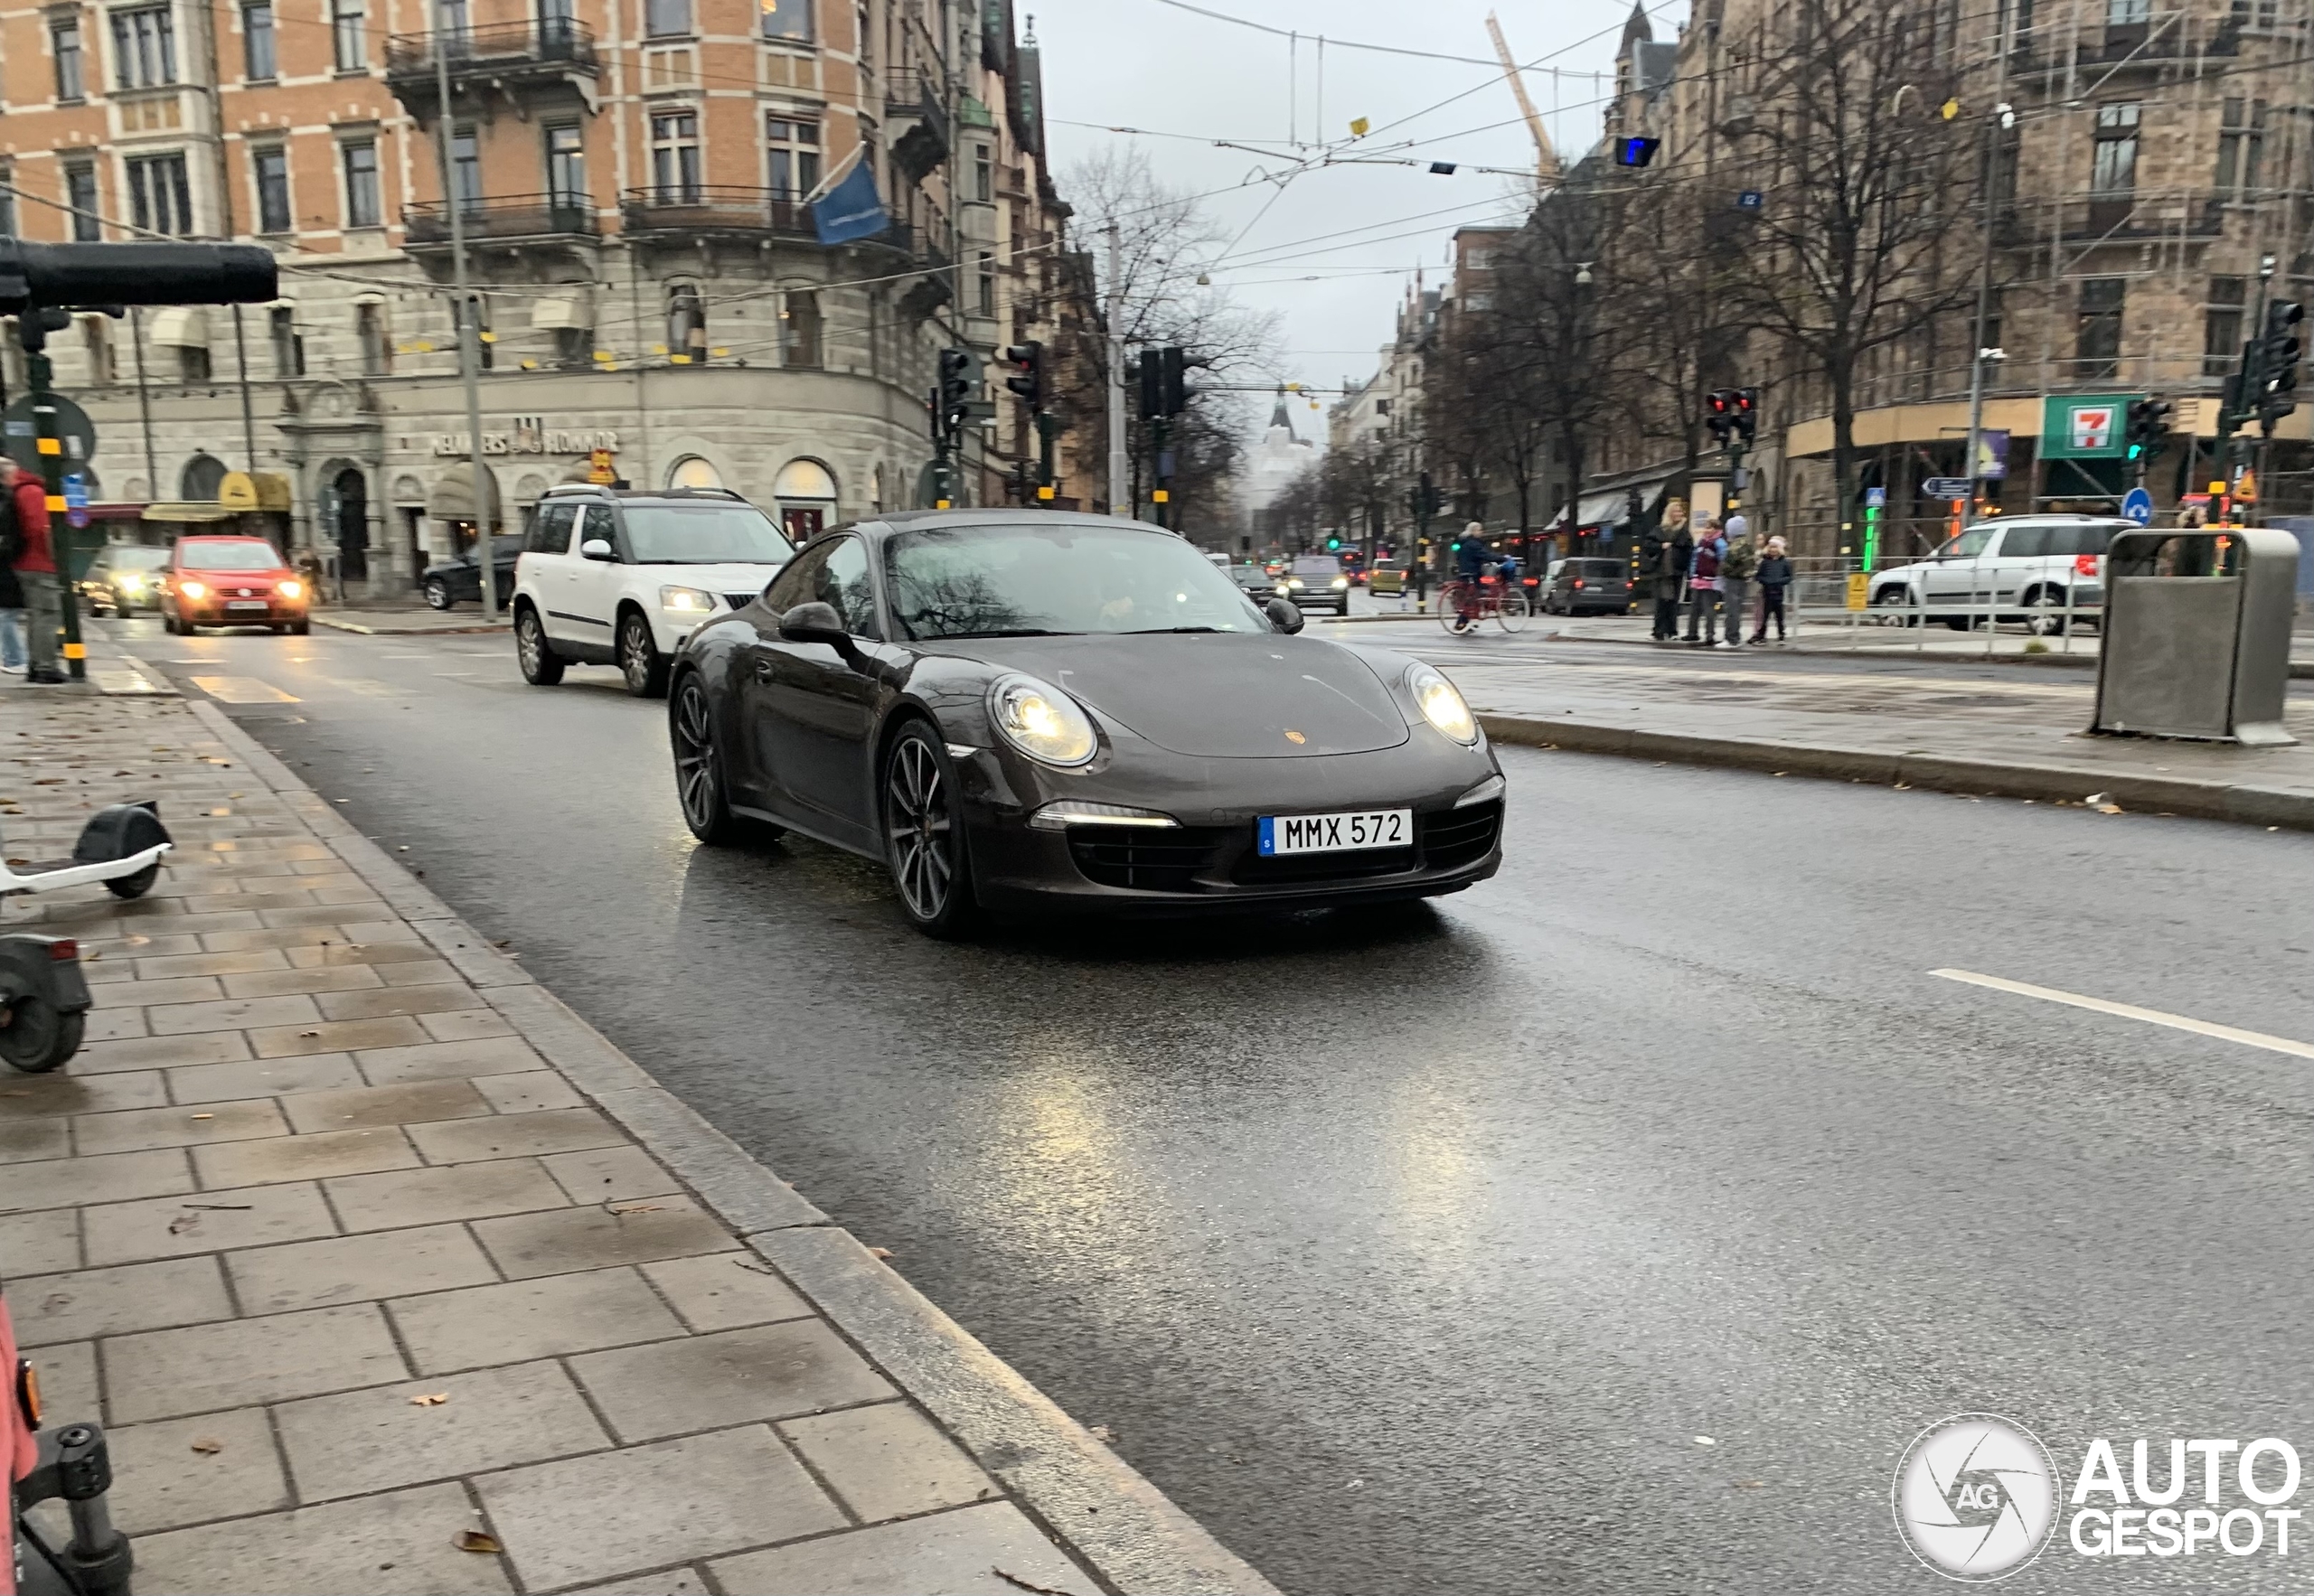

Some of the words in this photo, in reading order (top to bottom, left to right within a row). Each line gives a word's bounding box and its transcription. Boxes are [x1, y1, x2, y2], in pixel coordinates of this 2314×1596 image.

[1285, 817, 1341, 849] MMX
[1351, 813, 1401, 844] 572
[1264, 839, 1271, 848] S
